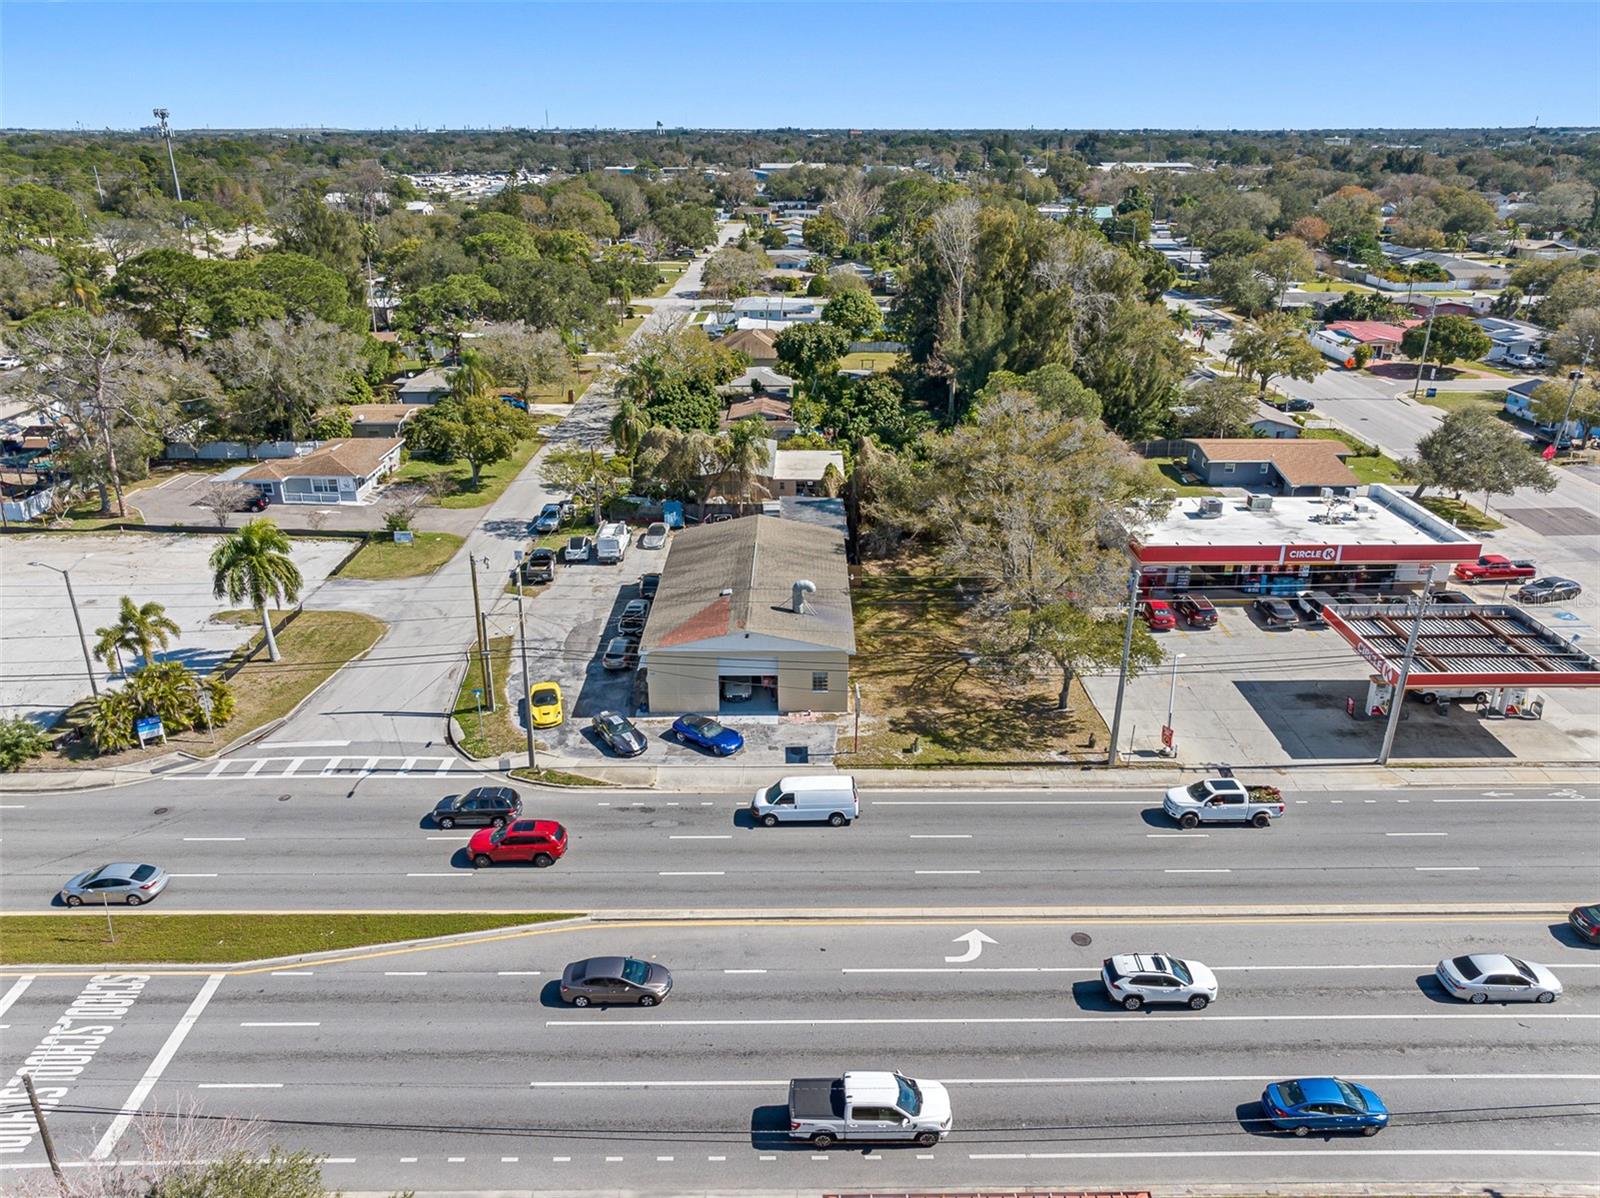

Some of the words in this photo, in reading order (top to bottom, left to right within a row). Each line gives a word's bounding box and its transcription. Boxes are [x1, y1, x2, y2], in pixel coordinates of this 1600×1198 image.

[1289, 550, 1322, 558] CIRCLE
[1324, 549, 1334, 559] K
[1358, 641, 1383, 671] CIRCLE
[56, 975, 151, 1029] SCHOOL
[6, 1025, 114, 1088] SCHOOL
